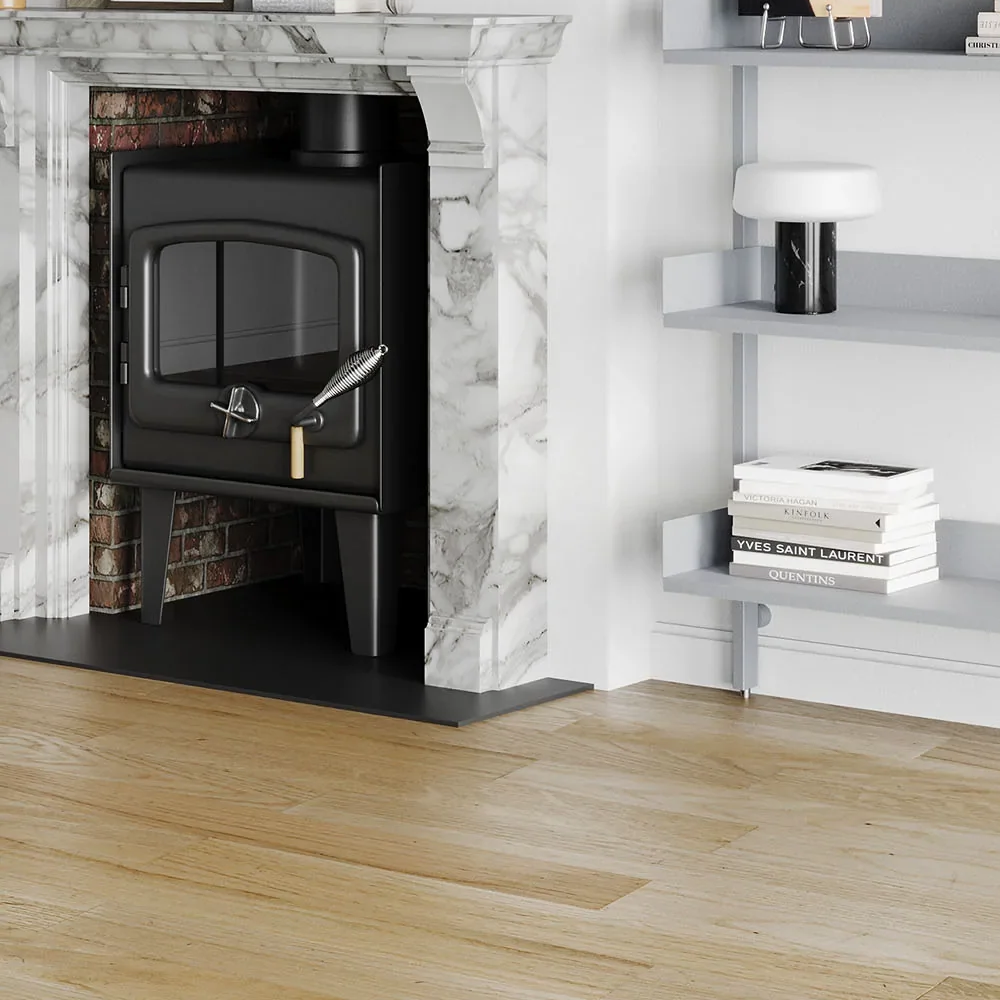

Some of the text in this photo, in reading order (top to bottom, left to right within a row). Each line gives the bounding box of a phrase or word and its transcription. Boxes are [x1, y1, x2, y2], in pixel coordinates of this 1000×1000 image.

[744, 494, 817, 506] VICTORIA HAGAN
[784, 508, 830, 520] KINFOLK
[737, 540, 884, 564] YVES SAINT LAURENT
[769, 570, 835, 586] QUENTINS
